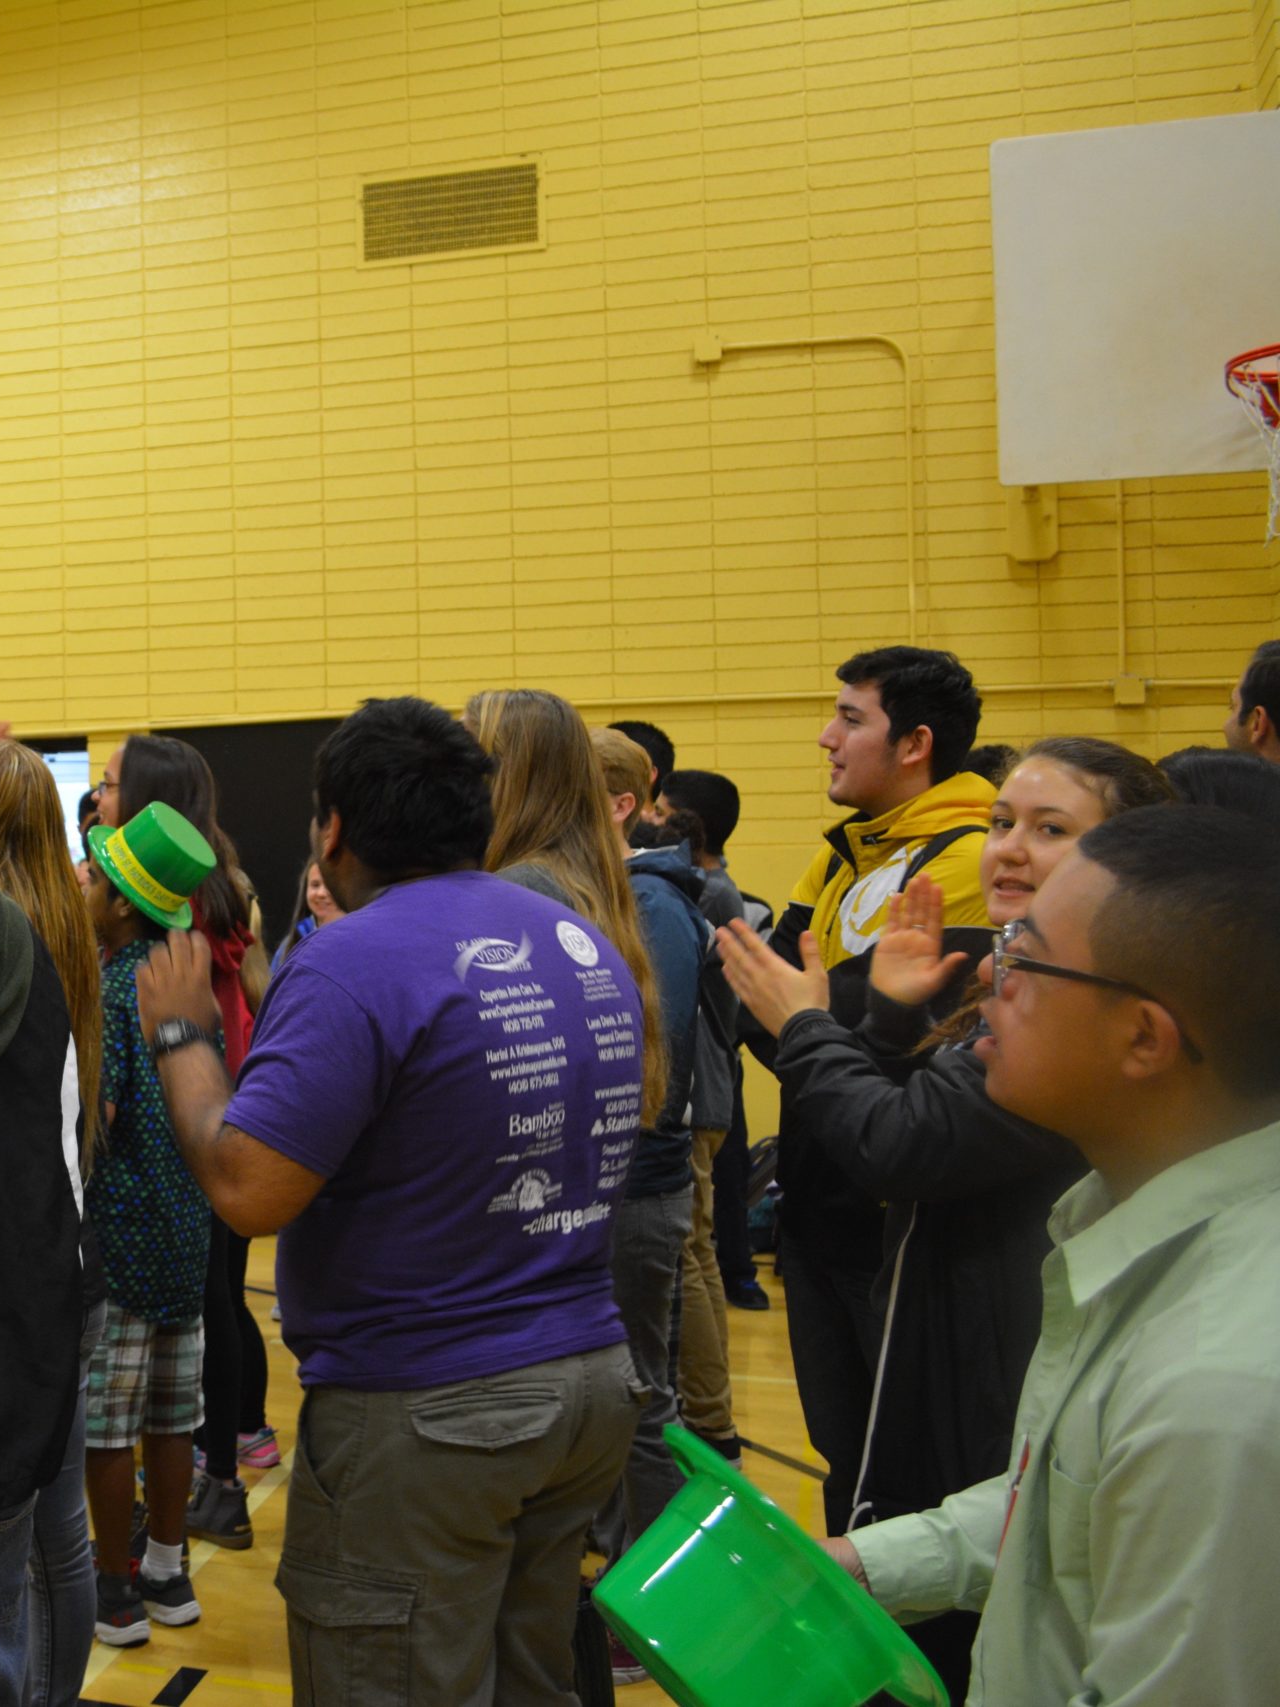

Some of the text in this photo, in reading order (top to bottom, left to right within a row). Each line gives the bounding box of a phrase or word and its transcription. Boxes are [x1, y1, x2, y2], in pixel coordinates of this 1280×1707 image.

[475, 945, 517, 963] VISION
[510, 1045, 516, 1059] A
[509, 1107, 566, 1137] Bamboo
